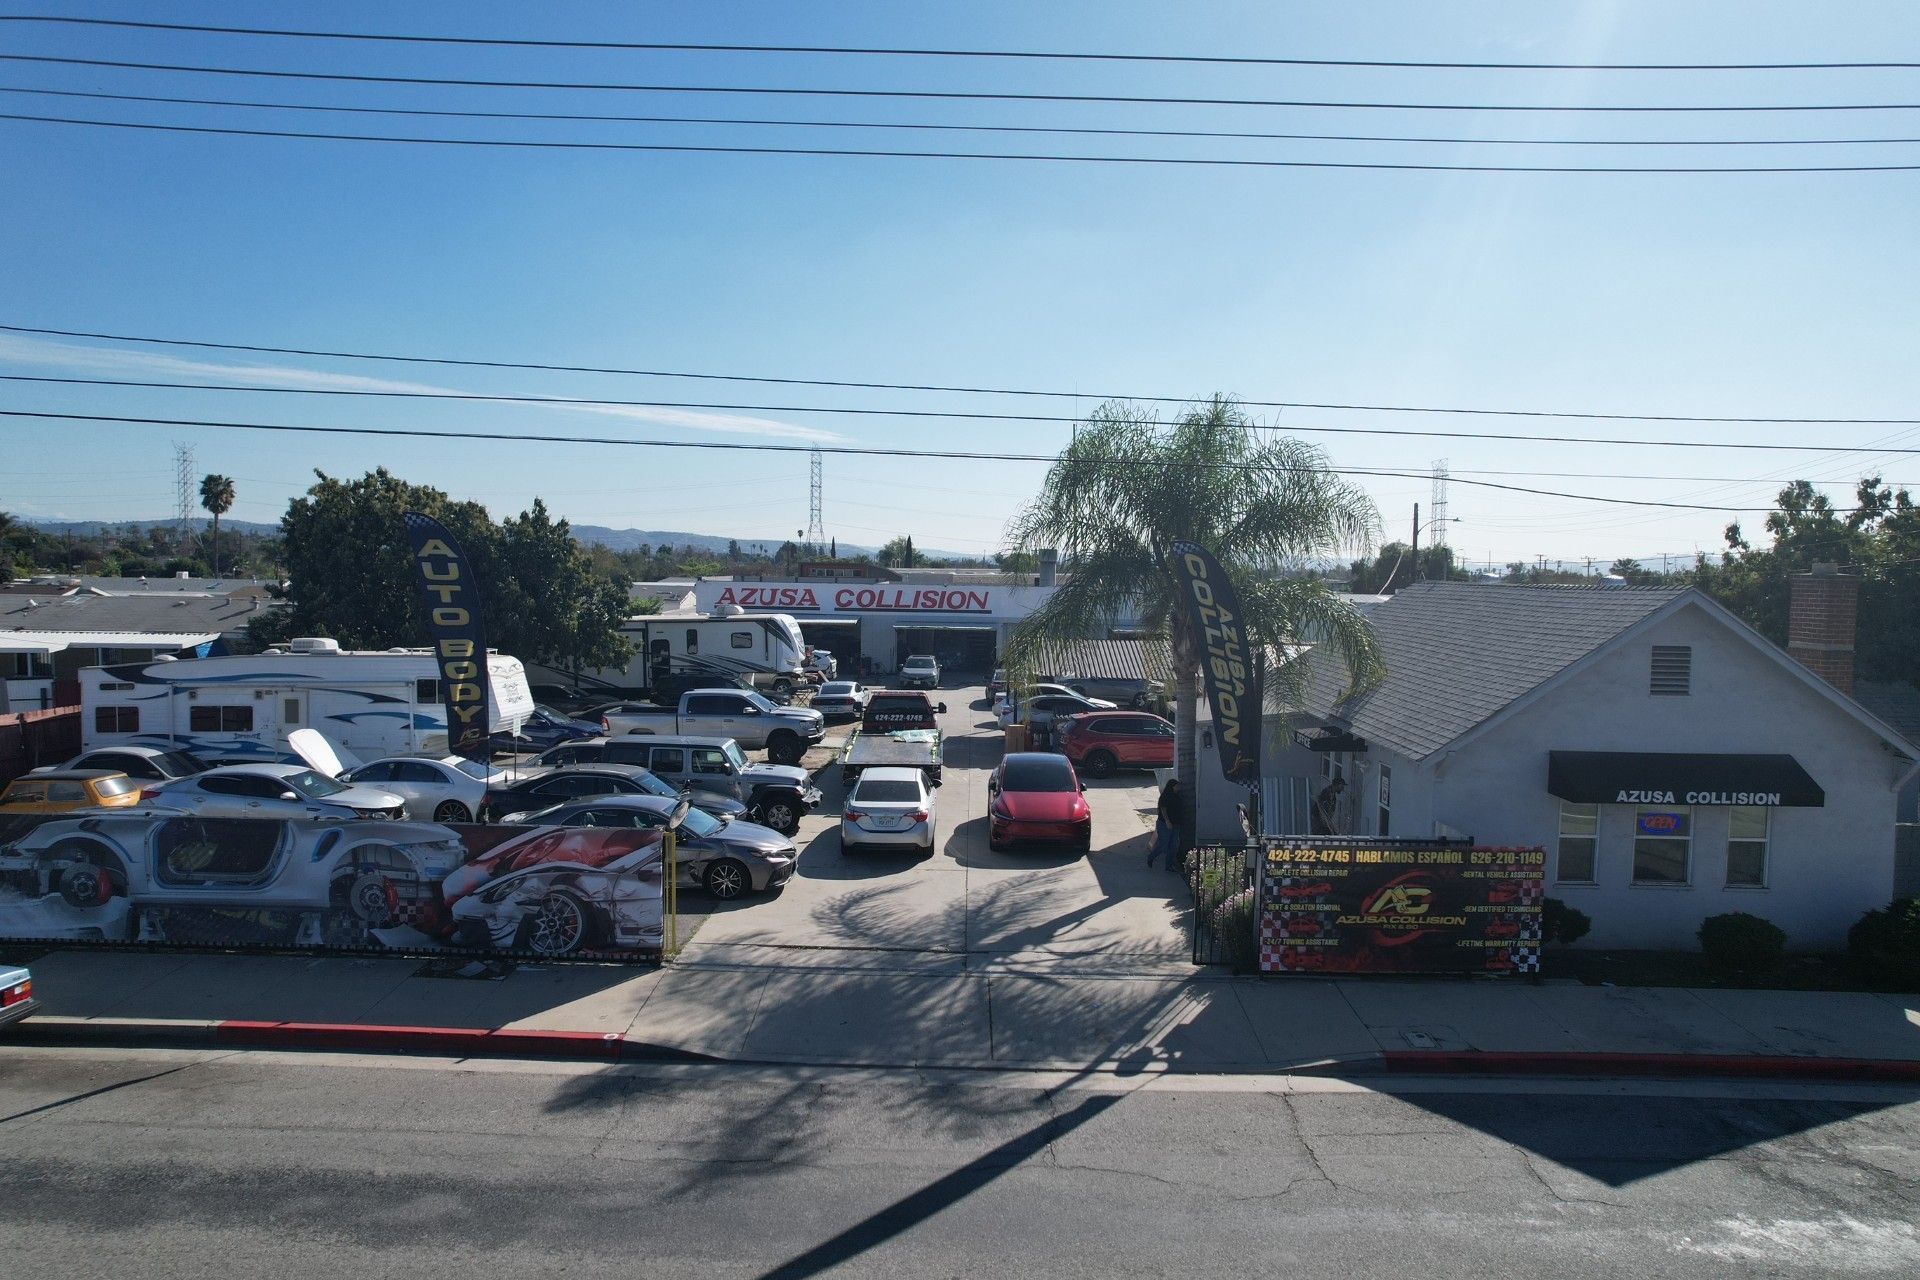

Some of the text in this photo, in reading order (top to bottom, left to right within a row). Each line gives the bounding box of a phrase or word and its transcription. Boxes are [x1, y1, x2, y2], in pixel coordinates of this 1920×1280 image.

[717, 587, 989, 610] AZUSA COLLISION
[418, 538, 484, 723] AUTO BODY
[1184, 552, 1240, 746] COLLISION
[1216, 603, 1246, 697] AZUSA
[1616, 790, 1781, 805] AZUSA COLLISION
[1268, 849, 1350, 862] 424-222-4745
[1355, 849, 1464, 864] HABLAMOS ESPAÑOL
[1470, 852, 1543, 865] 626-210-1149
[1299, 869, 1328, 877] COLLISION
[1328, 869, 1349, 877] REPAIR
[1335, 915, 1467, 926] AZUSA COLLISION
